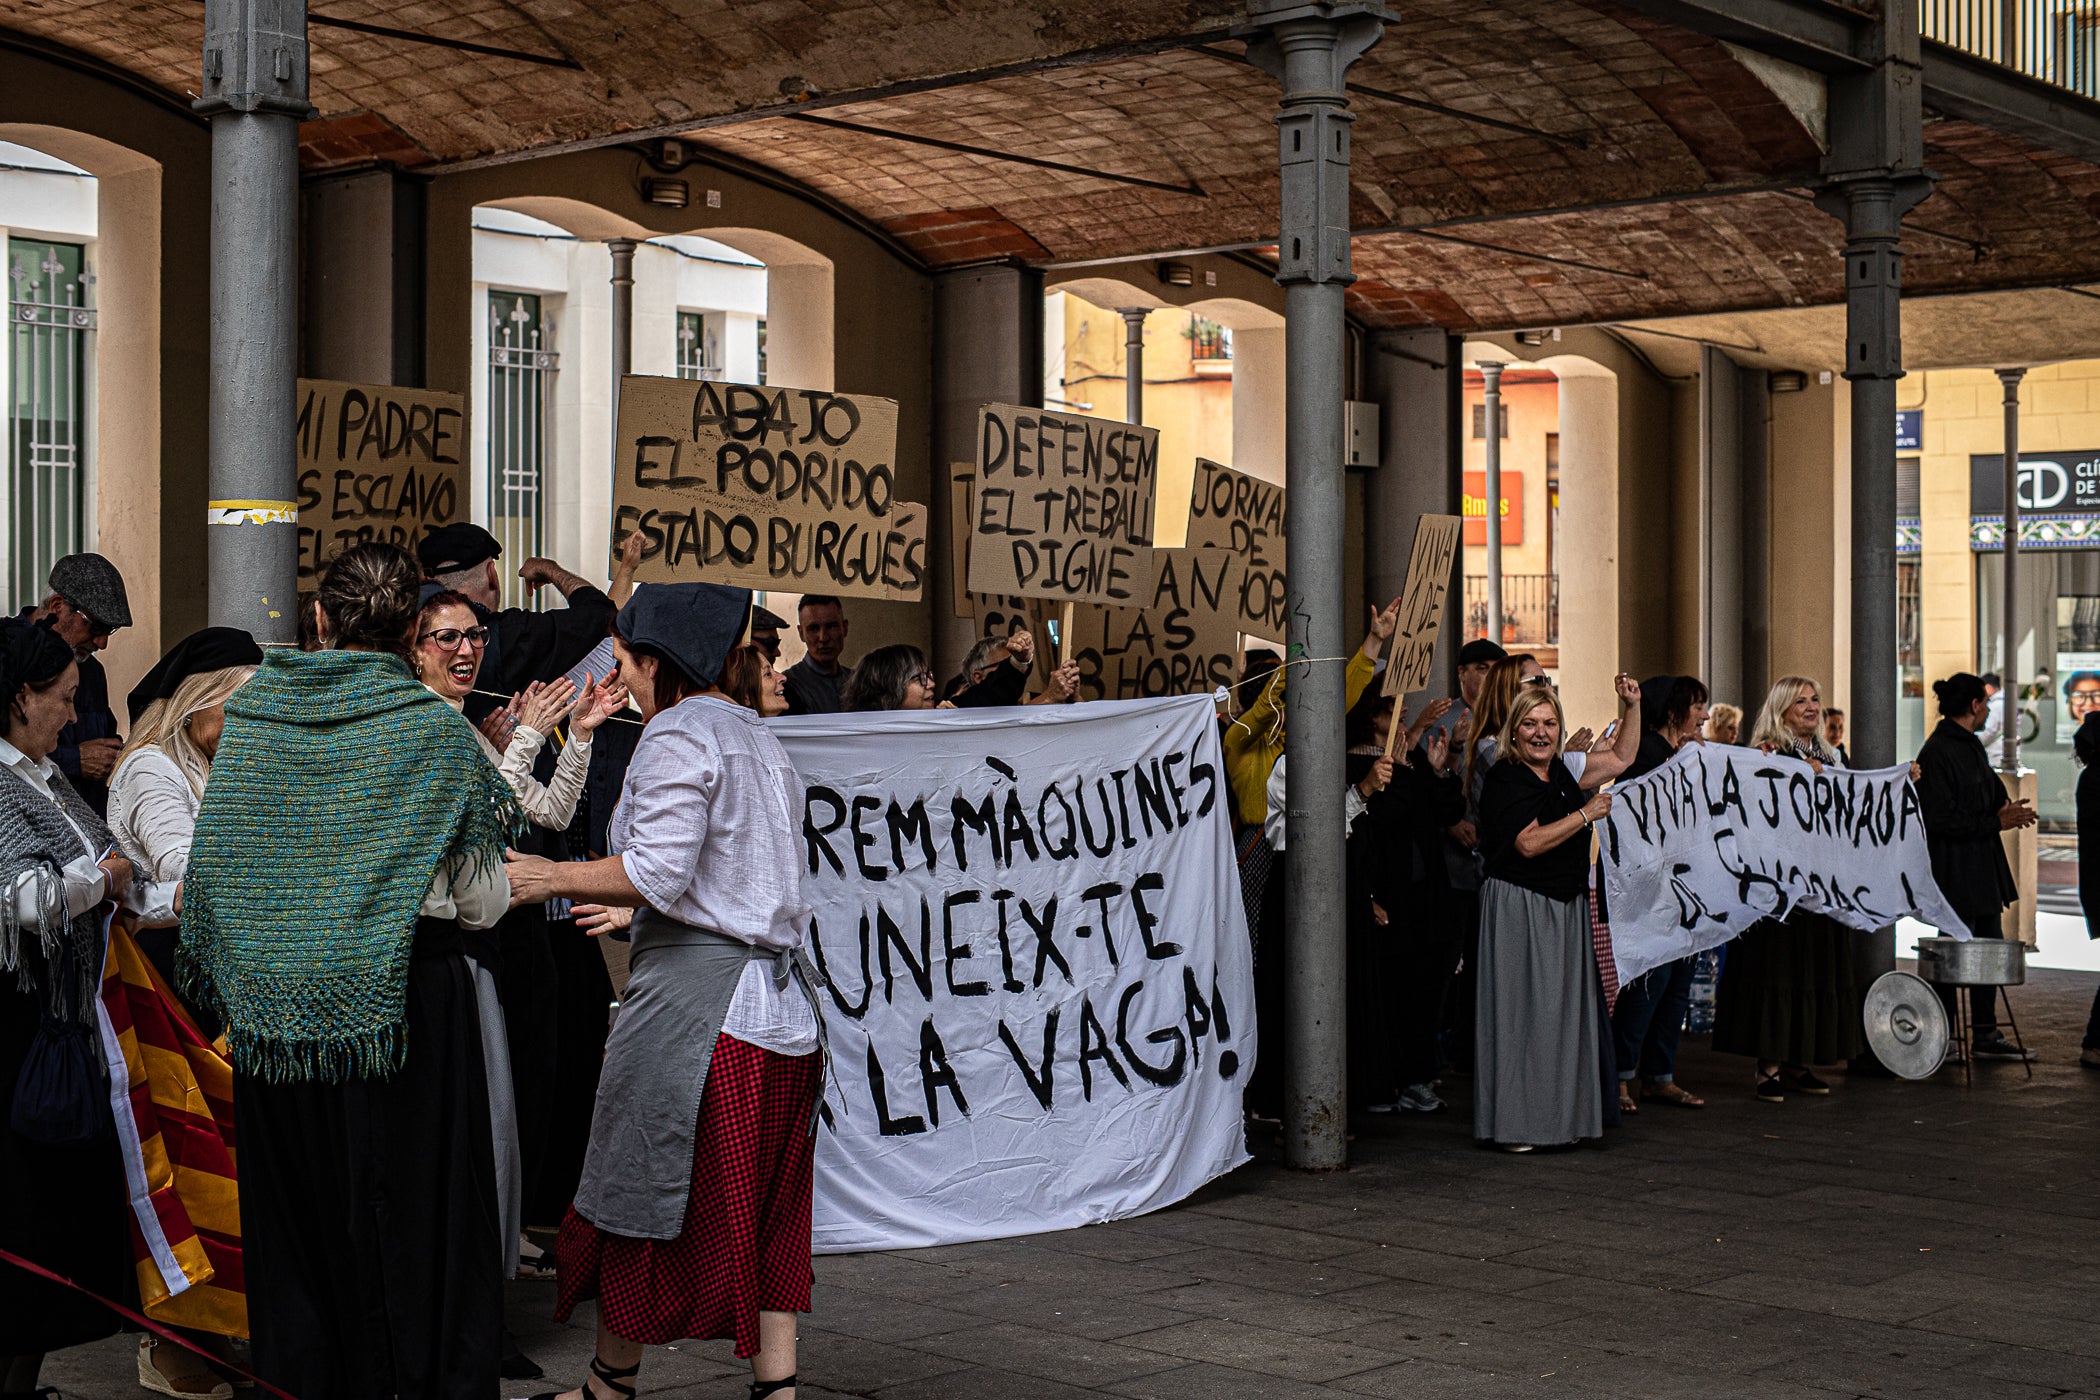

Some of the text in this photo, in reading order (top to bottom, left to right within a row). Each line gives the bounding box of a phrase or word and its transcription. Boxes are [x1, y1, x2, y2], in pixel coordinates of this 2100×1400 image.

[337, 389, 462, 464] PADRE
[692, 381, 861, 447] ABAJO
[635, 432, 895, 517] EL PODRIDO
[984, 411, 1160, 496] DEFENSEM
[332, 466, 457, 523] ESCLAVO
[978, 487, 1035, 536] EL
[1034, 485, 1154, 549] TREBALL
[1193, 463, 1287, 537] JORNA
[613, 505, 759, 573] ESTADO
[767, 513, 925, 591] BURGUÉS
[1012, 539, 1135, 599] DIGNE
[1230, 519, 1269, 567] DE
[1415, 523, 1454, 580] VIVA
[1103, 607, 1196, 656] LAS
[1416, 581, 1445, 636] DE
[1116, 653, 1234, 700] HORAS
[1386, 640, 1434, 689] MAYO
[951, 731, 1217, 872] MÀQUINES
[1697, 751, 1749, 829] LA
[809, 871, 1184, 1020] UNEIX-TE
[866, 1012, 973, 1137] LA
